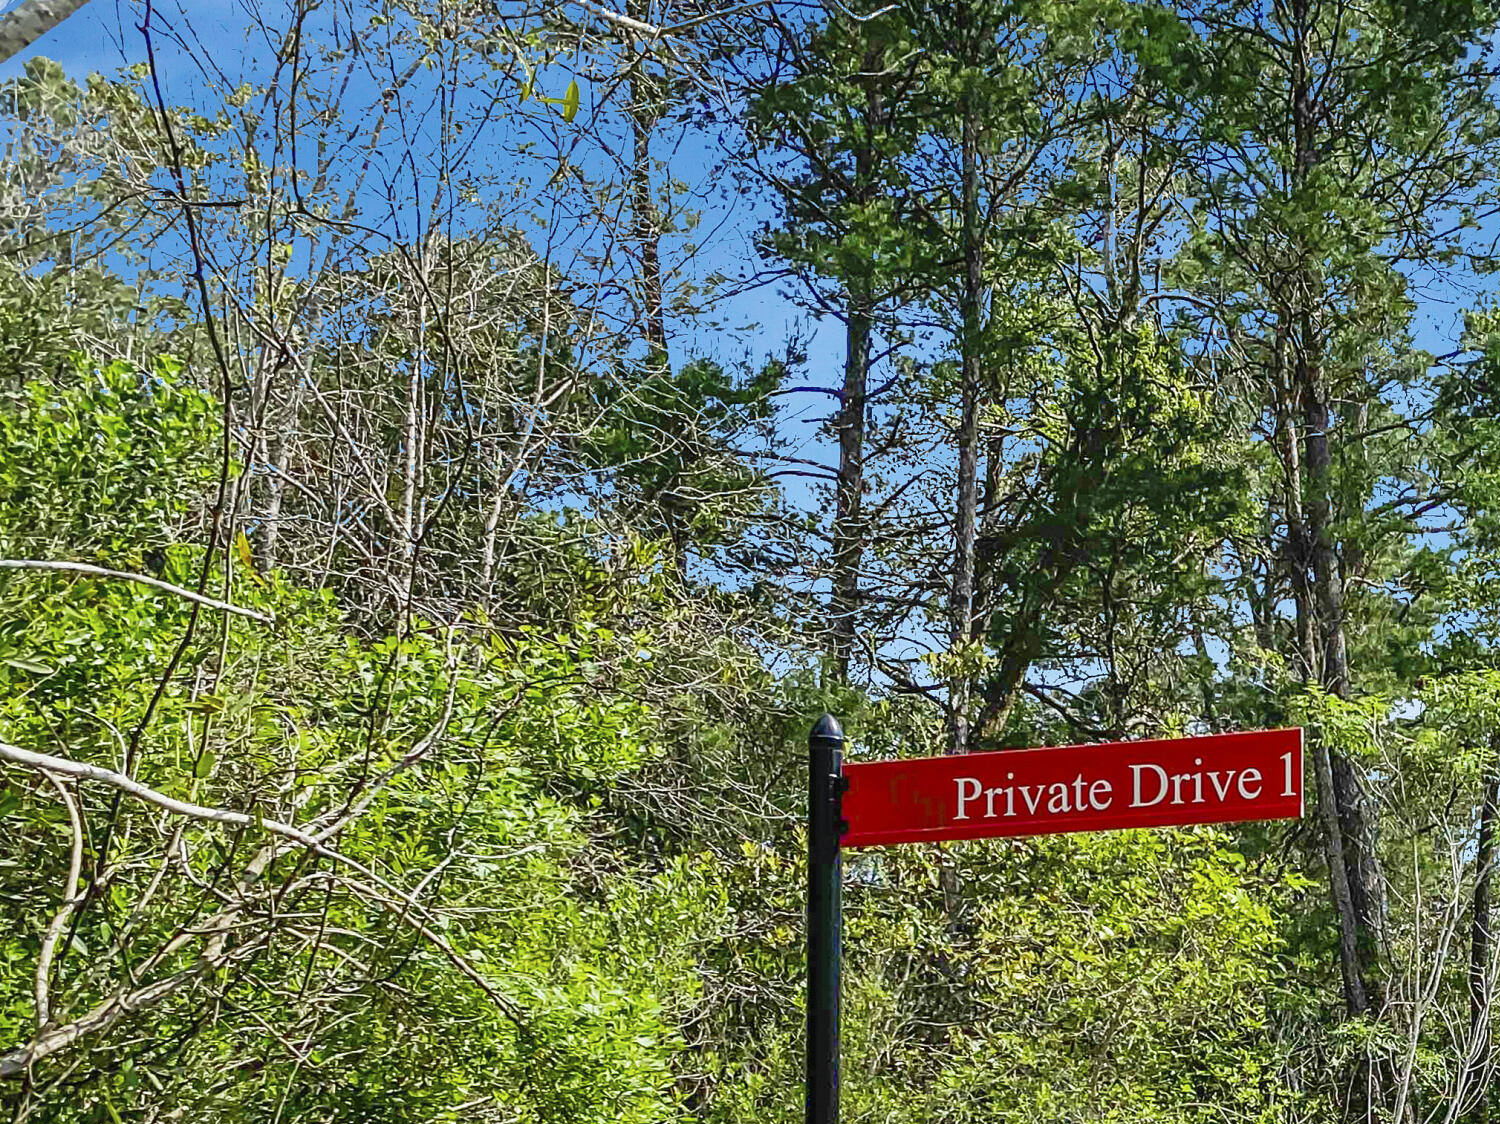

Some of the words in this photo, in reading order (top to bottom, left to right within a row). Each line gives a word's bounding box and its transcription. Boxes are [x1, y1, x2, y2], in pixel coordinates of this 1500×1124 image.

[952, 772, 1113, 820] Private
[1128, 758, 1263, 809] Drive
[1279, 751, 1297, 797] 1
